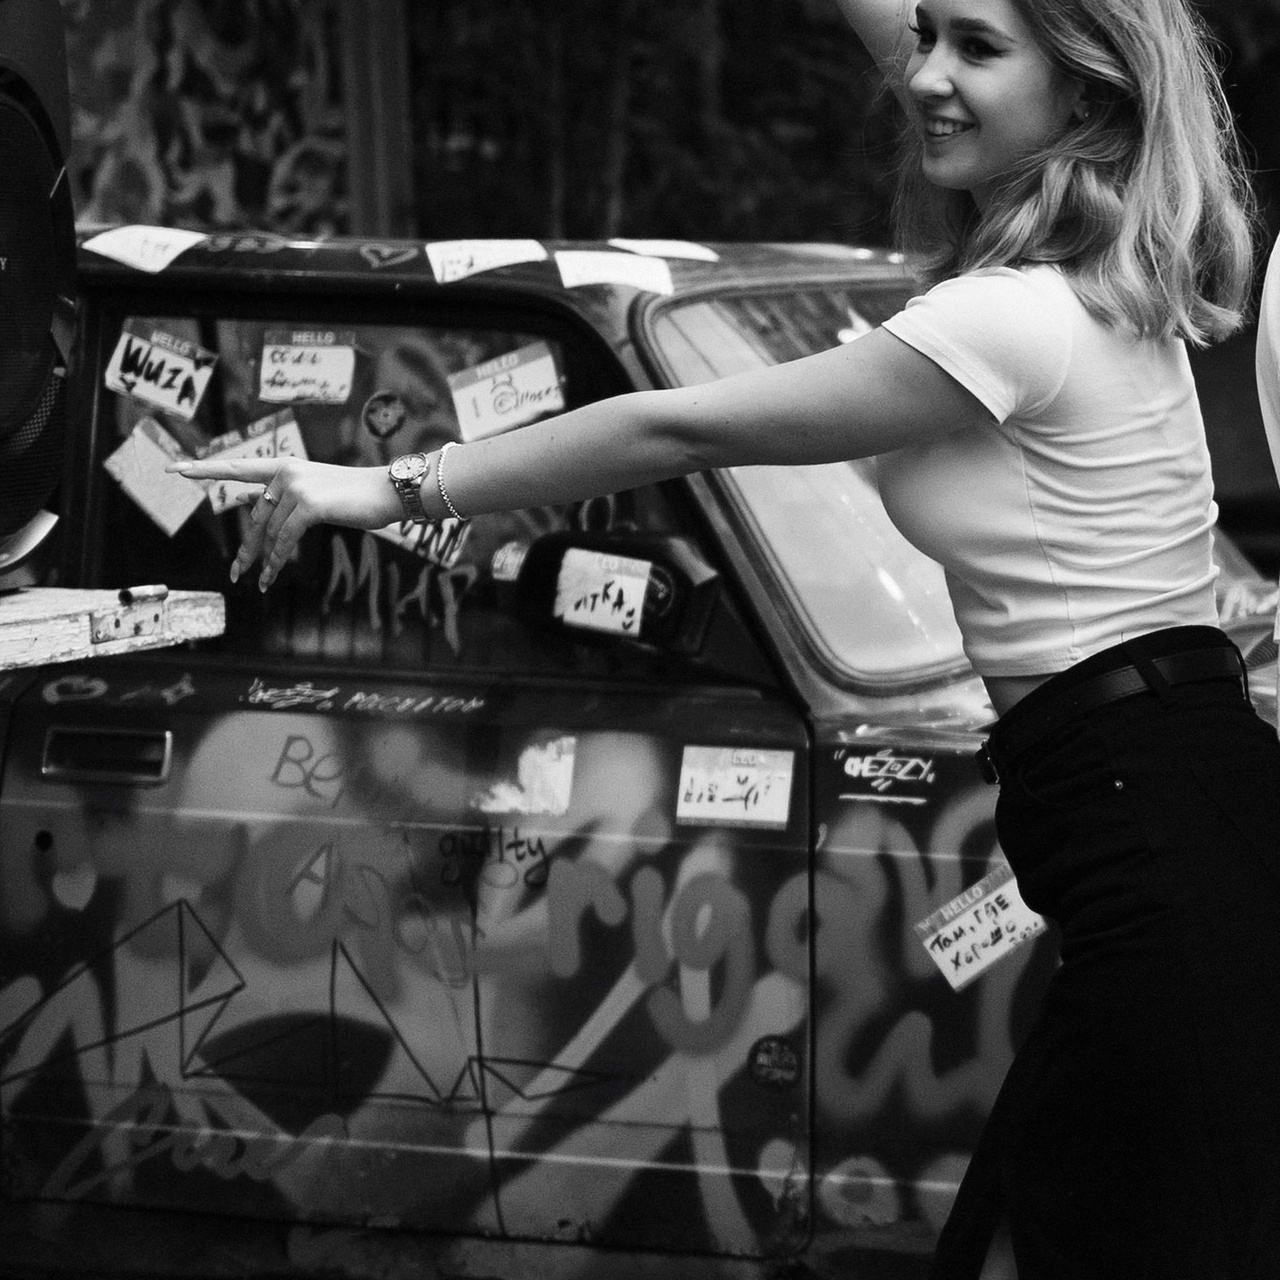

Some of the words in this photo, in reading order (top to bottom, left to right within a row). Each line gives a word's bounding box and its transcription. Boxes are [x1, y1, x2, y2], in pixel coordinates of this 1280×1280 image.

[151, 330, 192, 354] HELLO
[292, 331, 335, 345] HELLO
[940, 886, 983, 920] HELLO
